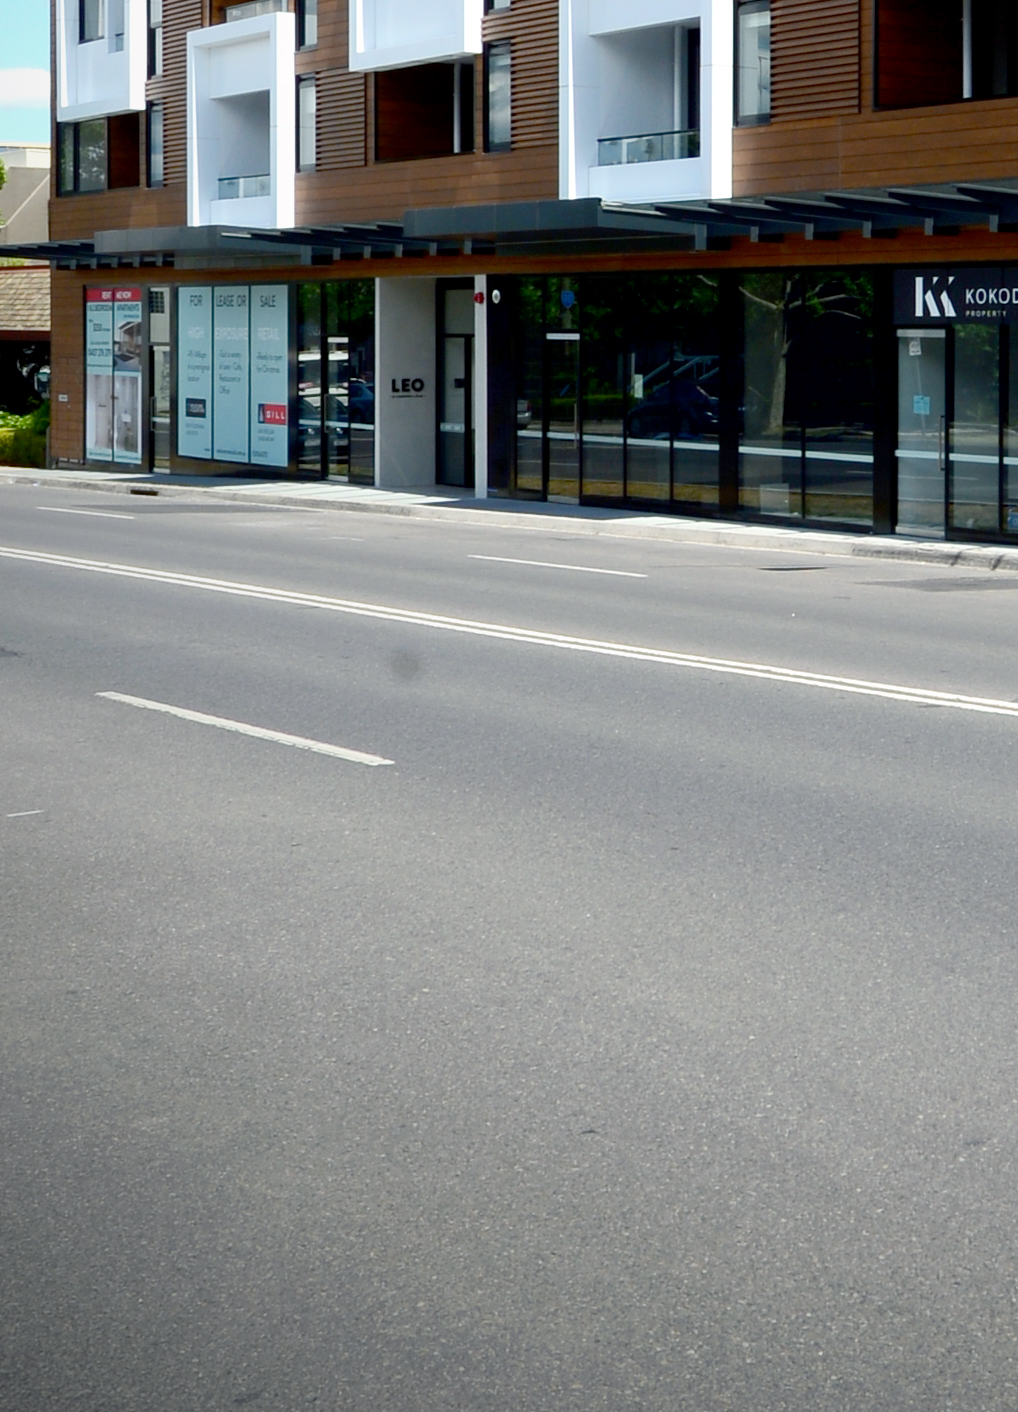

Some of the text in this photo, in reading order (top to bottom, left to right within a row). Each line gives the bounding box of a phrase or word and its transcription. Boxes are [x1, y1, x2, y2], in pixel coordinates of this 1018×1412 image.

[189, 294, 276, 308] FOR LEASE OR SALE
[965, 310, 1008, 318] PROPERTY
[258, 327, 280, 340] RETAIL
[391, 378, 424, 393] LEO
[266, 410, 286, 420] GILL
